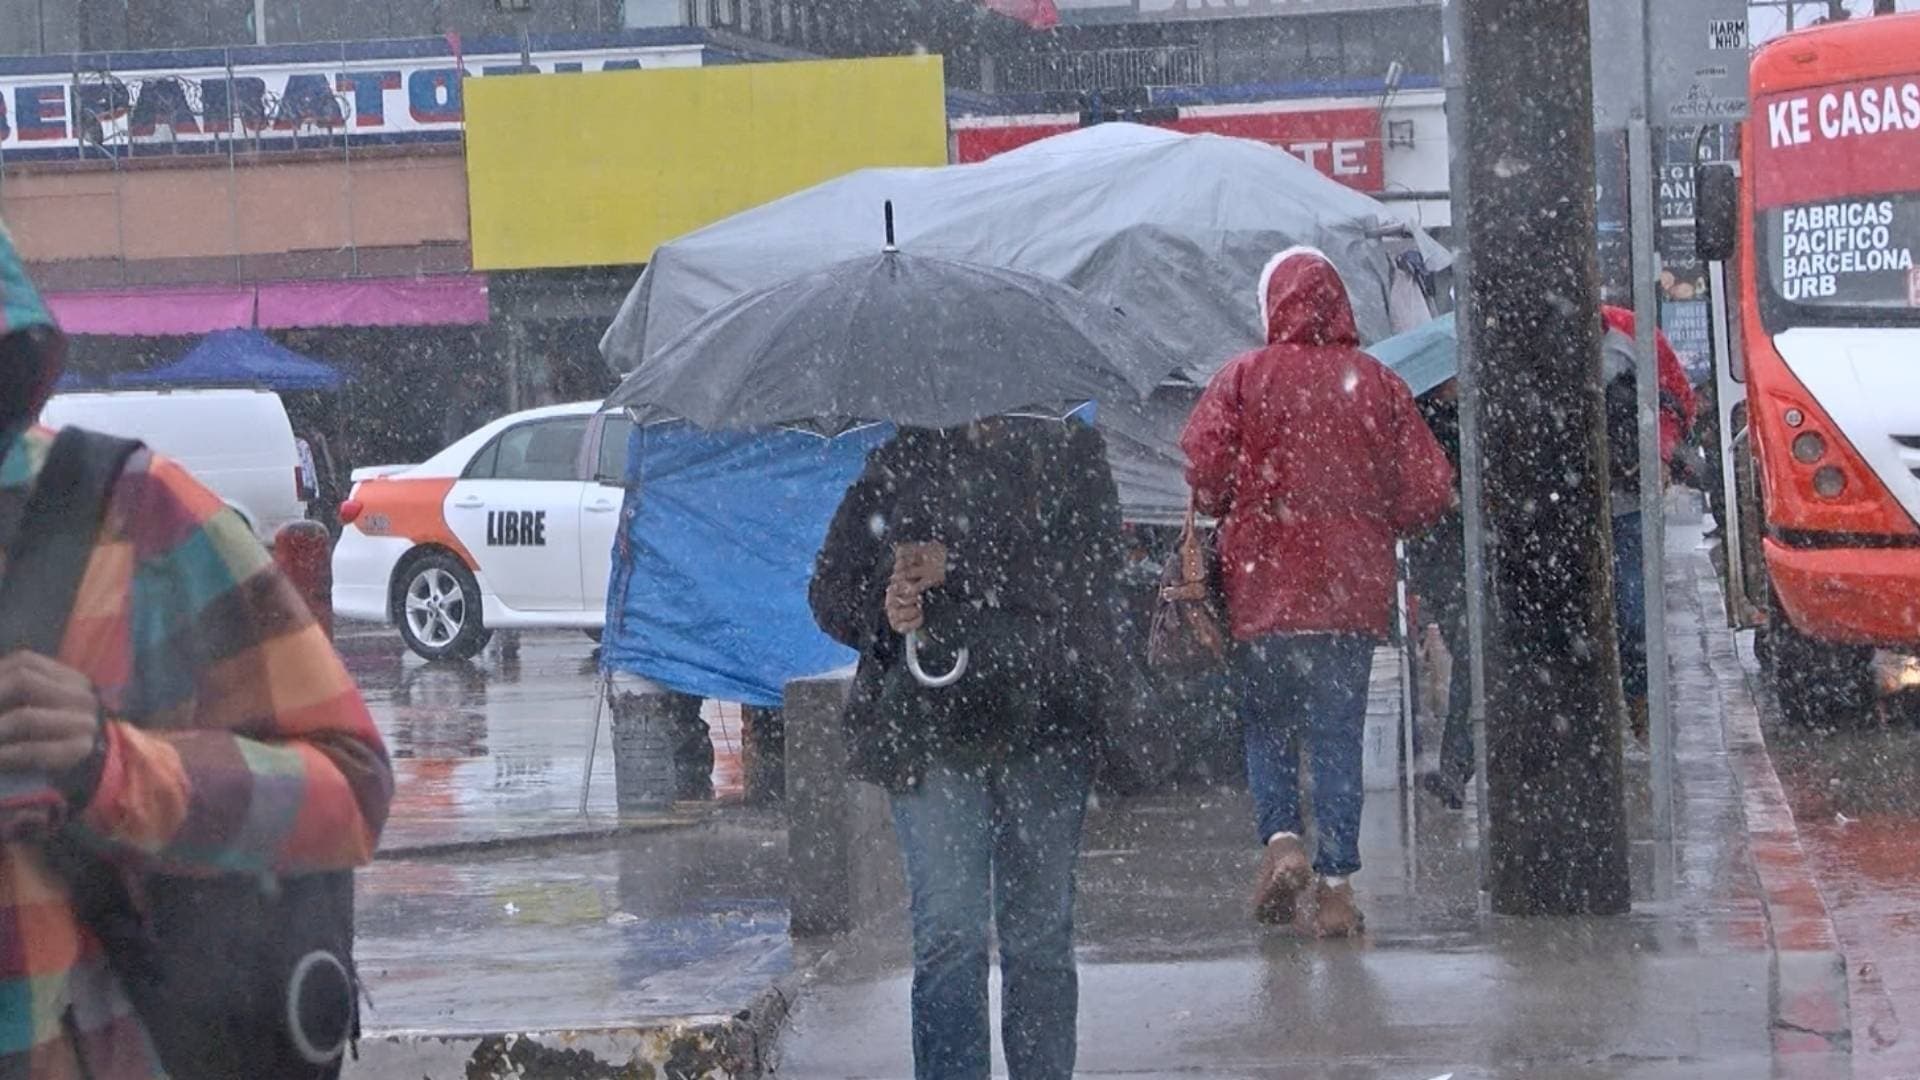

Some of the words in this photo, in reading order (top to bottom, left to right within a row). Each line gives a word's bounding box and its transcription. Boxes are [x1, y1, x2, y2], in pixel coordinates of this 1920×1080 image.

[1710, 22, 1744, 34] HARM
[1769, 98, 1812, 148] KE
[1819, 83, 1920, 139] CASAS
[1783, 201, 1893, 233] FABRICAS
[1783, 225, 1889, 257] PACIFICO
[1783, 248, 1913, 280] BARCELONA
[1783, 274, 1837, 301] URB
[487, 510, 546, 546] LIBRE
